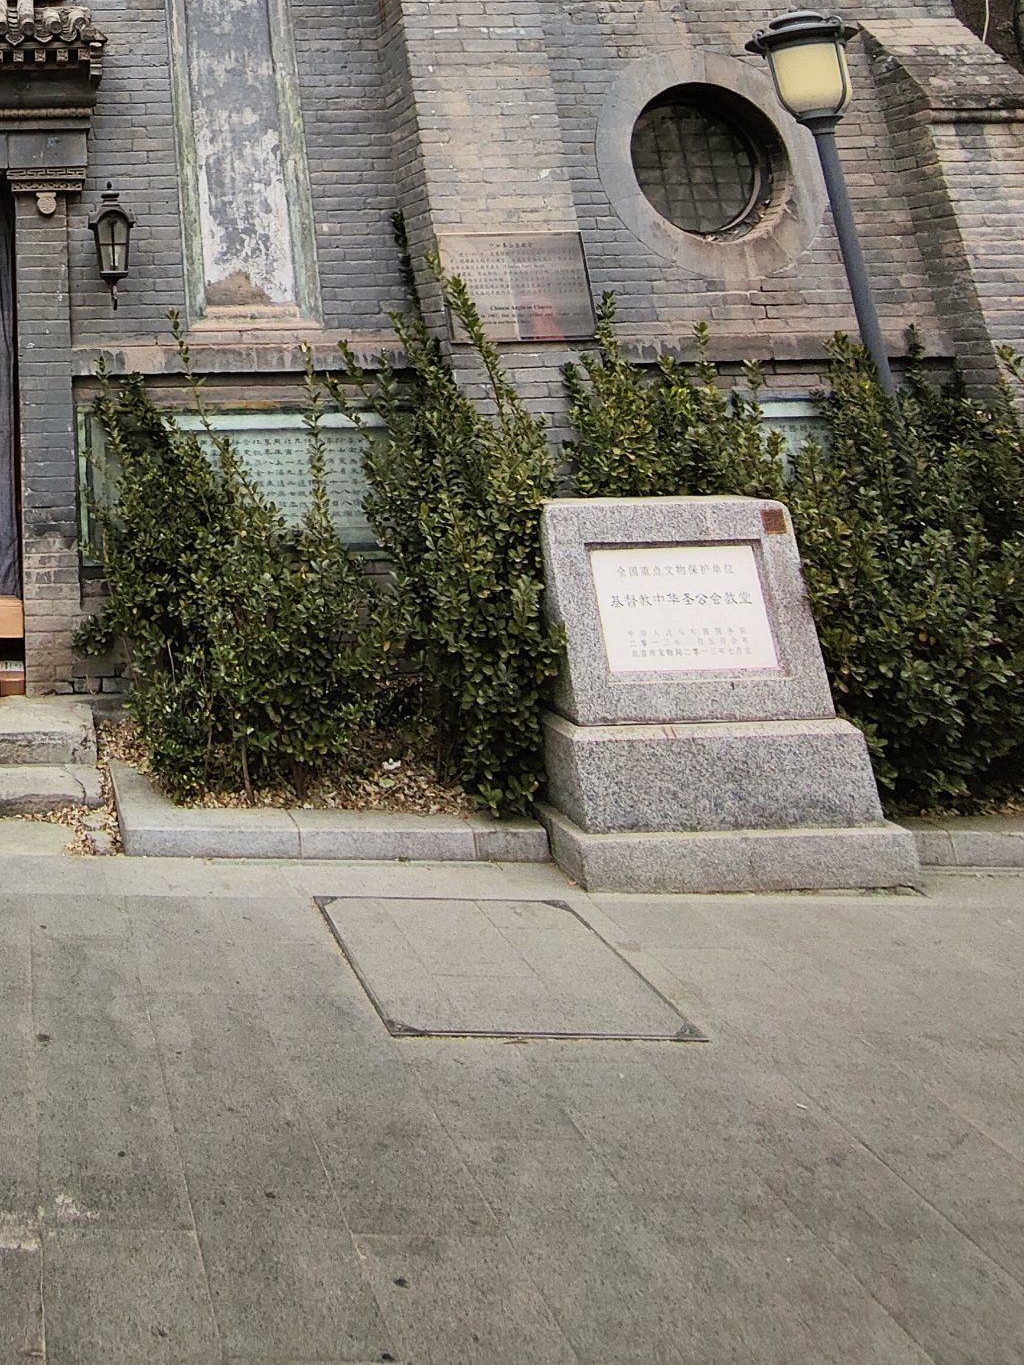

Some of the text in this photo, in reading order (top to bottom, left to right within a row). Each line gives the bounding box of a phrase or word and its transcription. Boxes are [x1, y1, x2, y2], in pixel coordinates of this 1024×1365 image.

[616, 563, 735, 577] 全国重点文物保护单位
[610, 591, 753, 608] 基督教中华圣公会教堂
[629, 637, 749, 648] 二零一三年月五日公布
